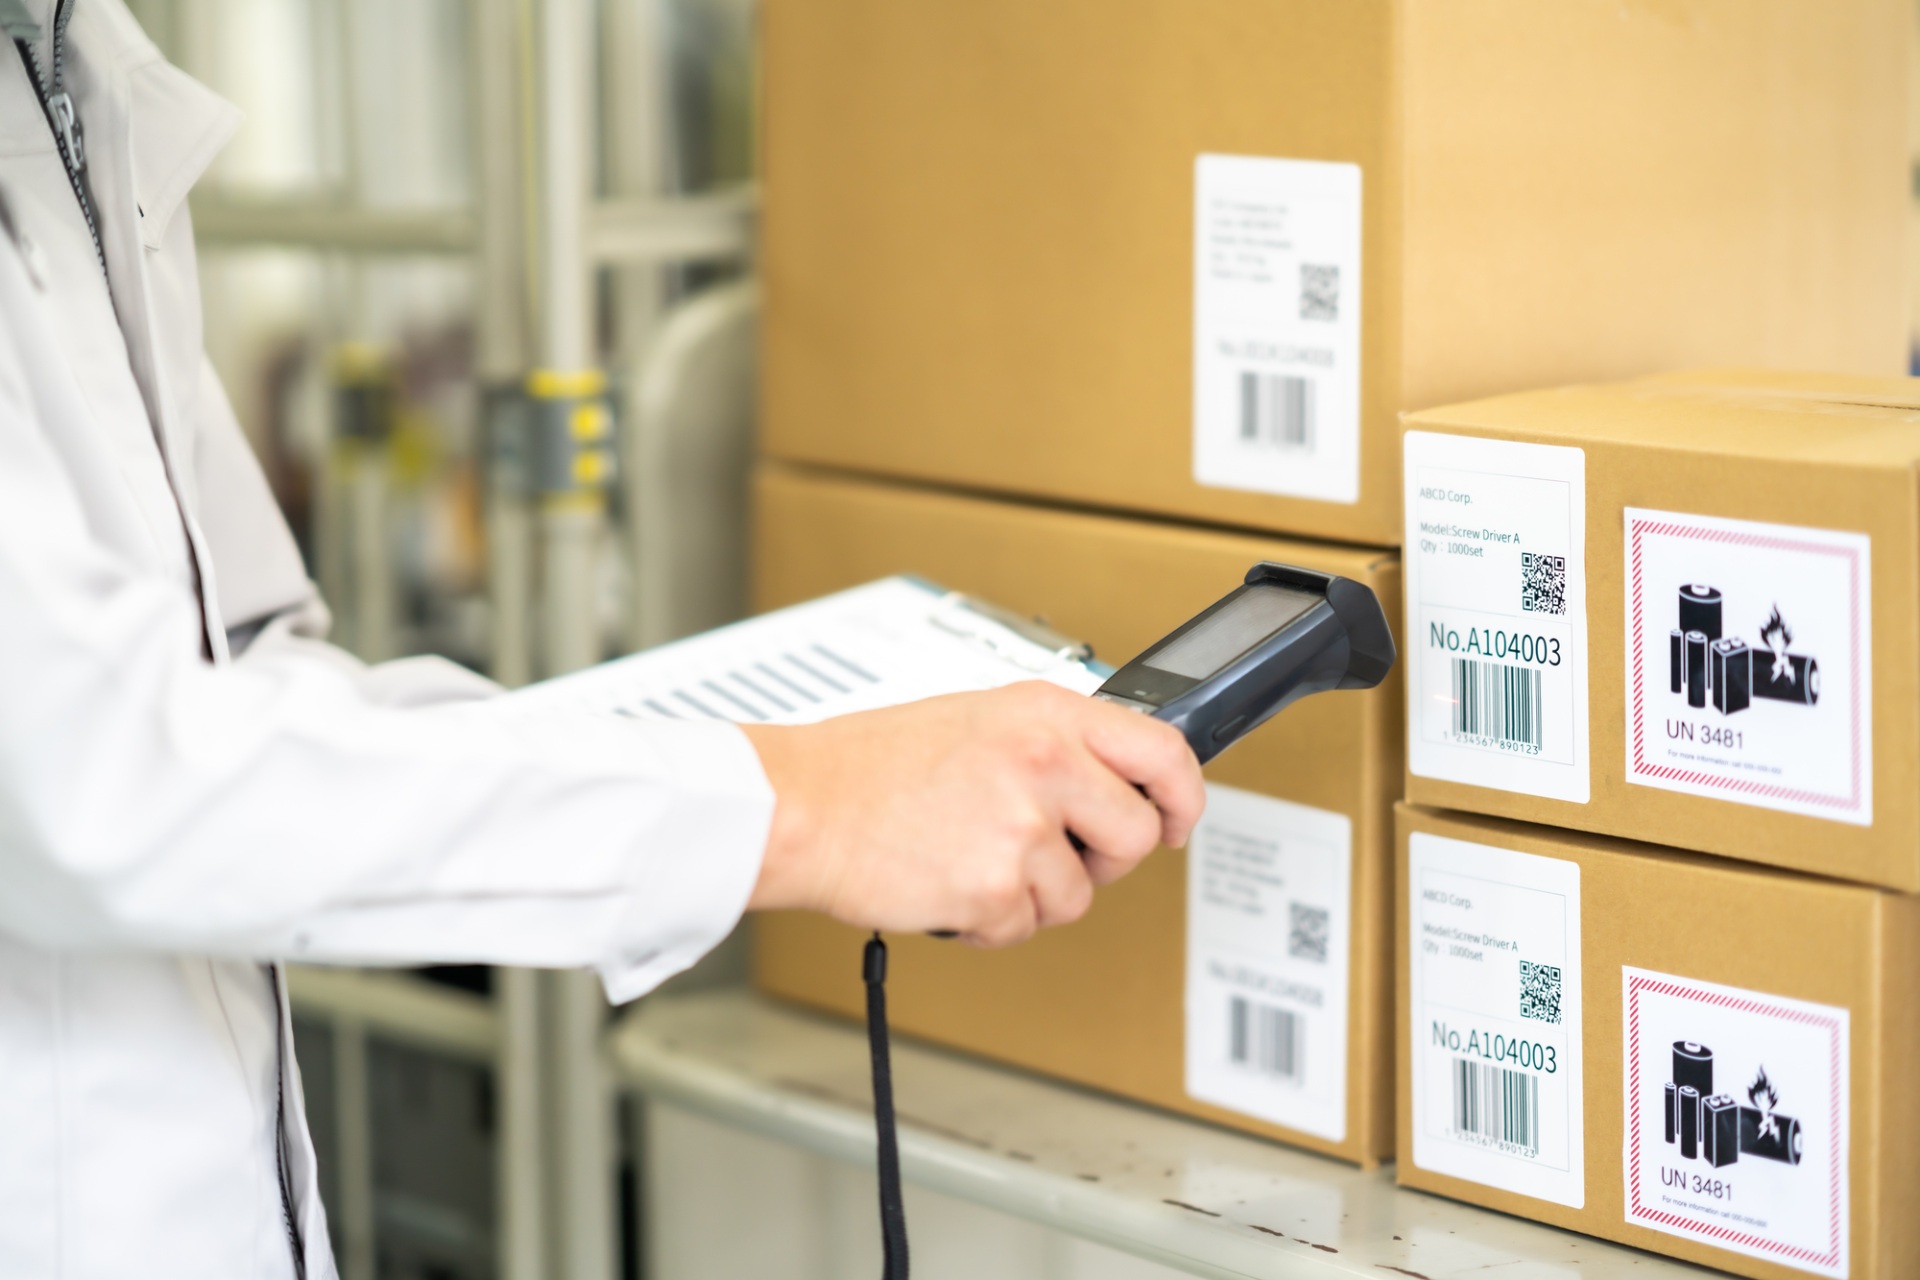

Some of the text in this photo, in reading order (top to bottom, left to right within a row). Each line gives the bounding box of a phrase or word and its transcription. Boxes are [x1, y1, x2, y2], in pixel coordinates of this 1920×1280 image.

[1419, 487, 1473, 506] ABCD Corp.
[1482, 529, 1512, 544] Driver
[1513, 532, 1521, 544] A
[1420, 539, 1437, 555] Qty
[1430, 621, 1561, 666] No.A104003
[1666, 718, 1743, 749] UN 3481
[1667, 749, 1678, 757] For
[1679, 752, 1695, 760] more
[1696, 754, 1729, 766] information
[1422, 889, 1474, 909] ABCD Corp.
[1482, 934, 1511, 950] Driver
[1512, 941, 1518, 952] A
[1432, 1020, 1557, 1074] No.A104003
[1661, 1166, 1732, 1201] UN 3481
[1662, 1195, 1671, 1203] For
[1673, 1198, 1688, 1208] more
[1688, 1202, 1719, 1215] information
